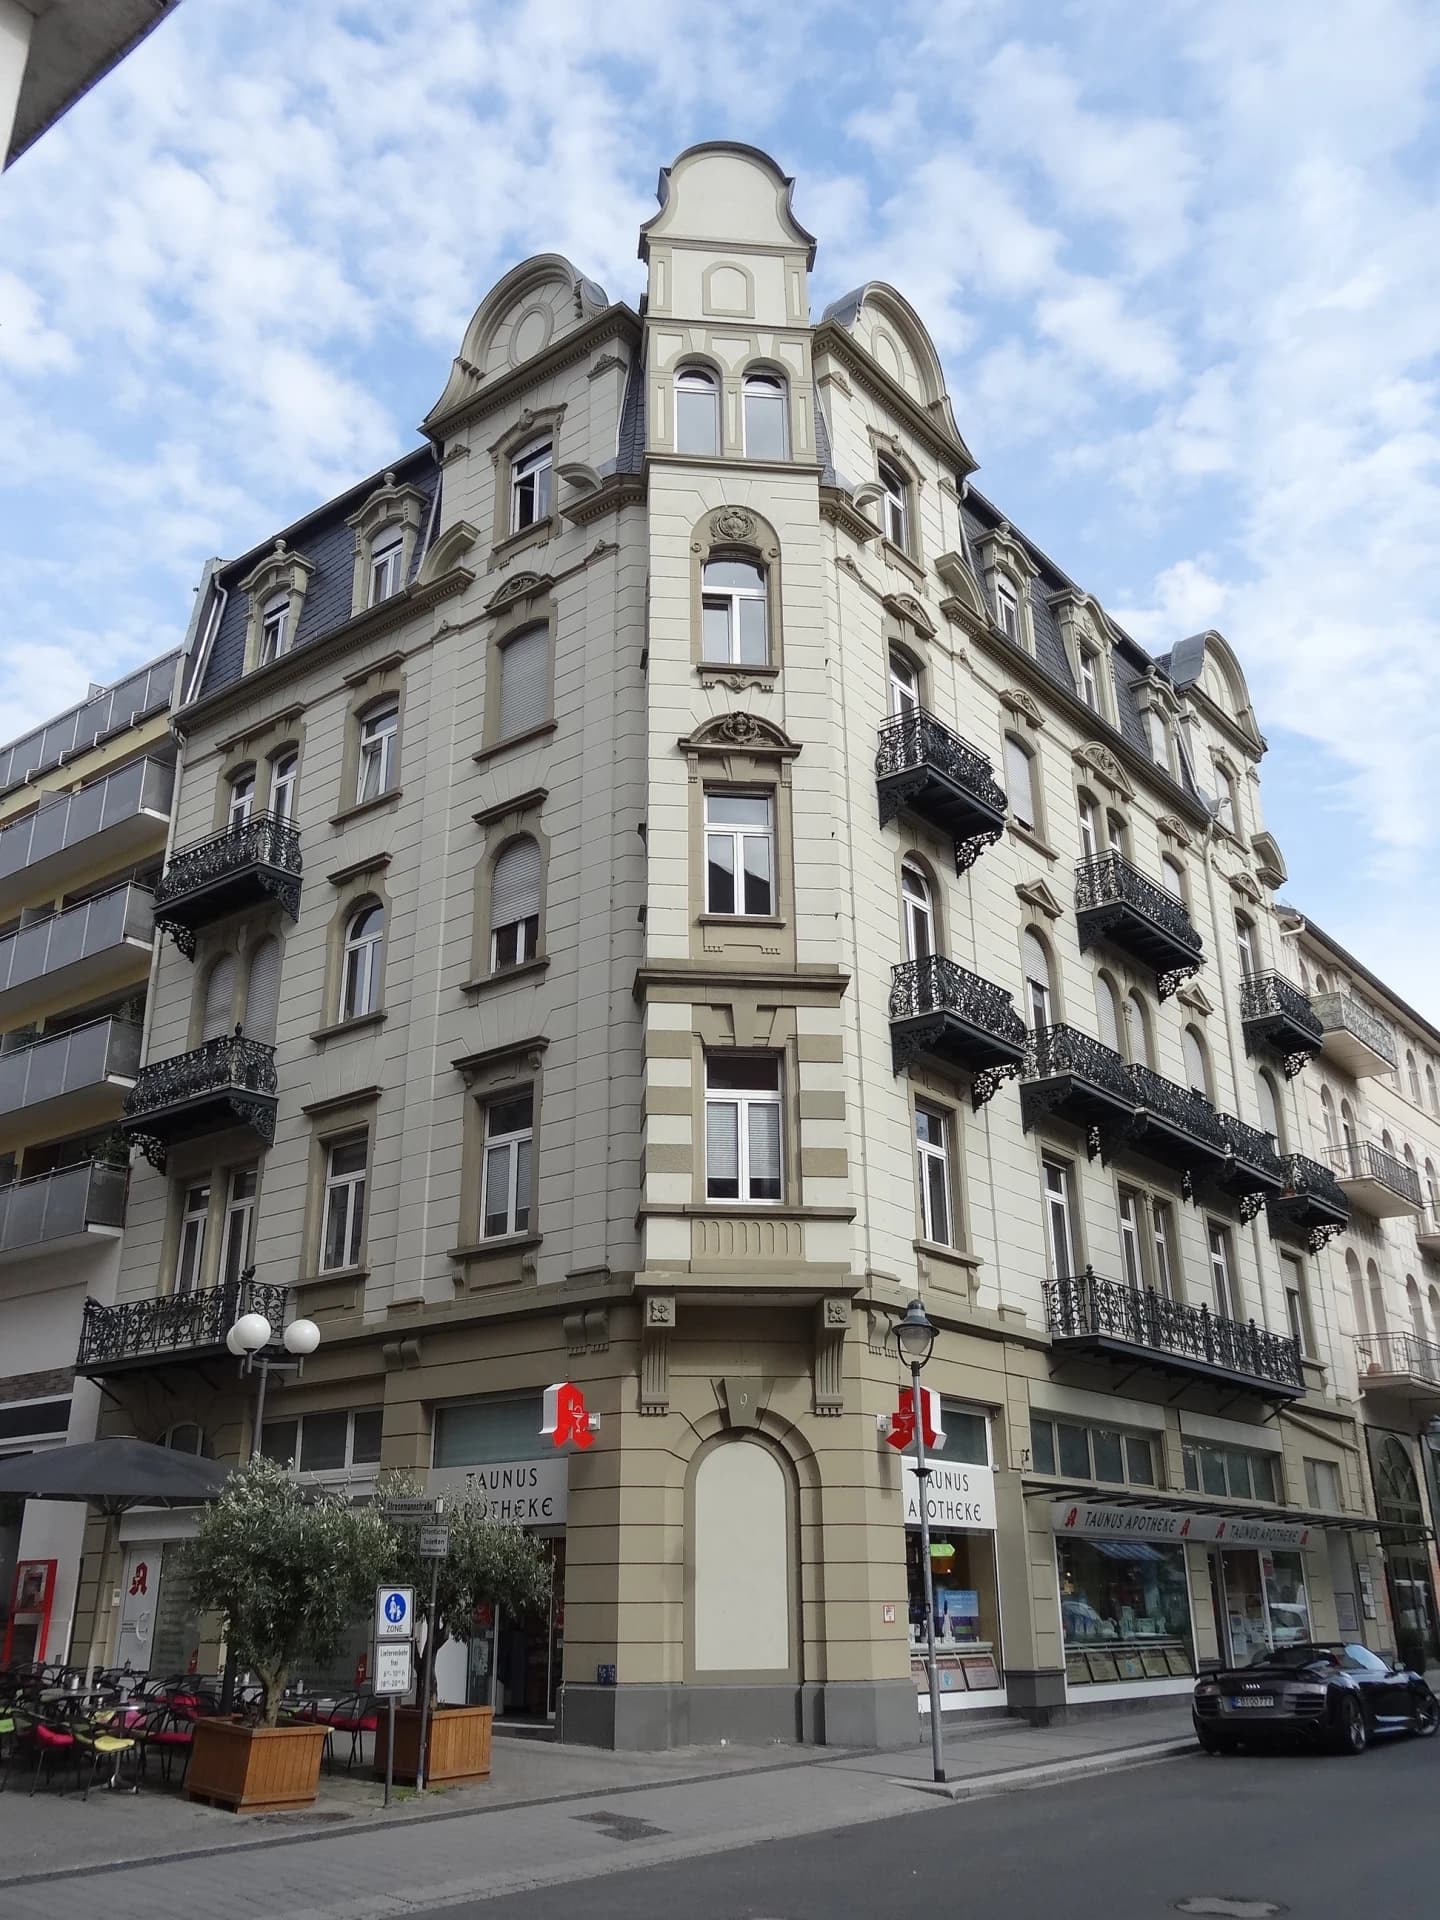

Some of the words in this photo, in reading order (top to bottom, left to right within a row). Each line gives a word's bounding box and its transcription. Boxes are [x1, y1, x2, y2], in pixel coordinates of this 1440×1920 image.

[466, 1467, 538, 1490] TAUNUS
[925, 1471, 969, 1492] AUNUS
[1085, 1511, 1124, 1529] TAUNUS
[1125, 1516, 1177, 1533] APOTHEKE
[1231, 1524, 1260, 1540] TAUNUS
[1260, 1527, 1299, 1543] APOTHEKE
[386, 1624, 403, 1633] ZONE
